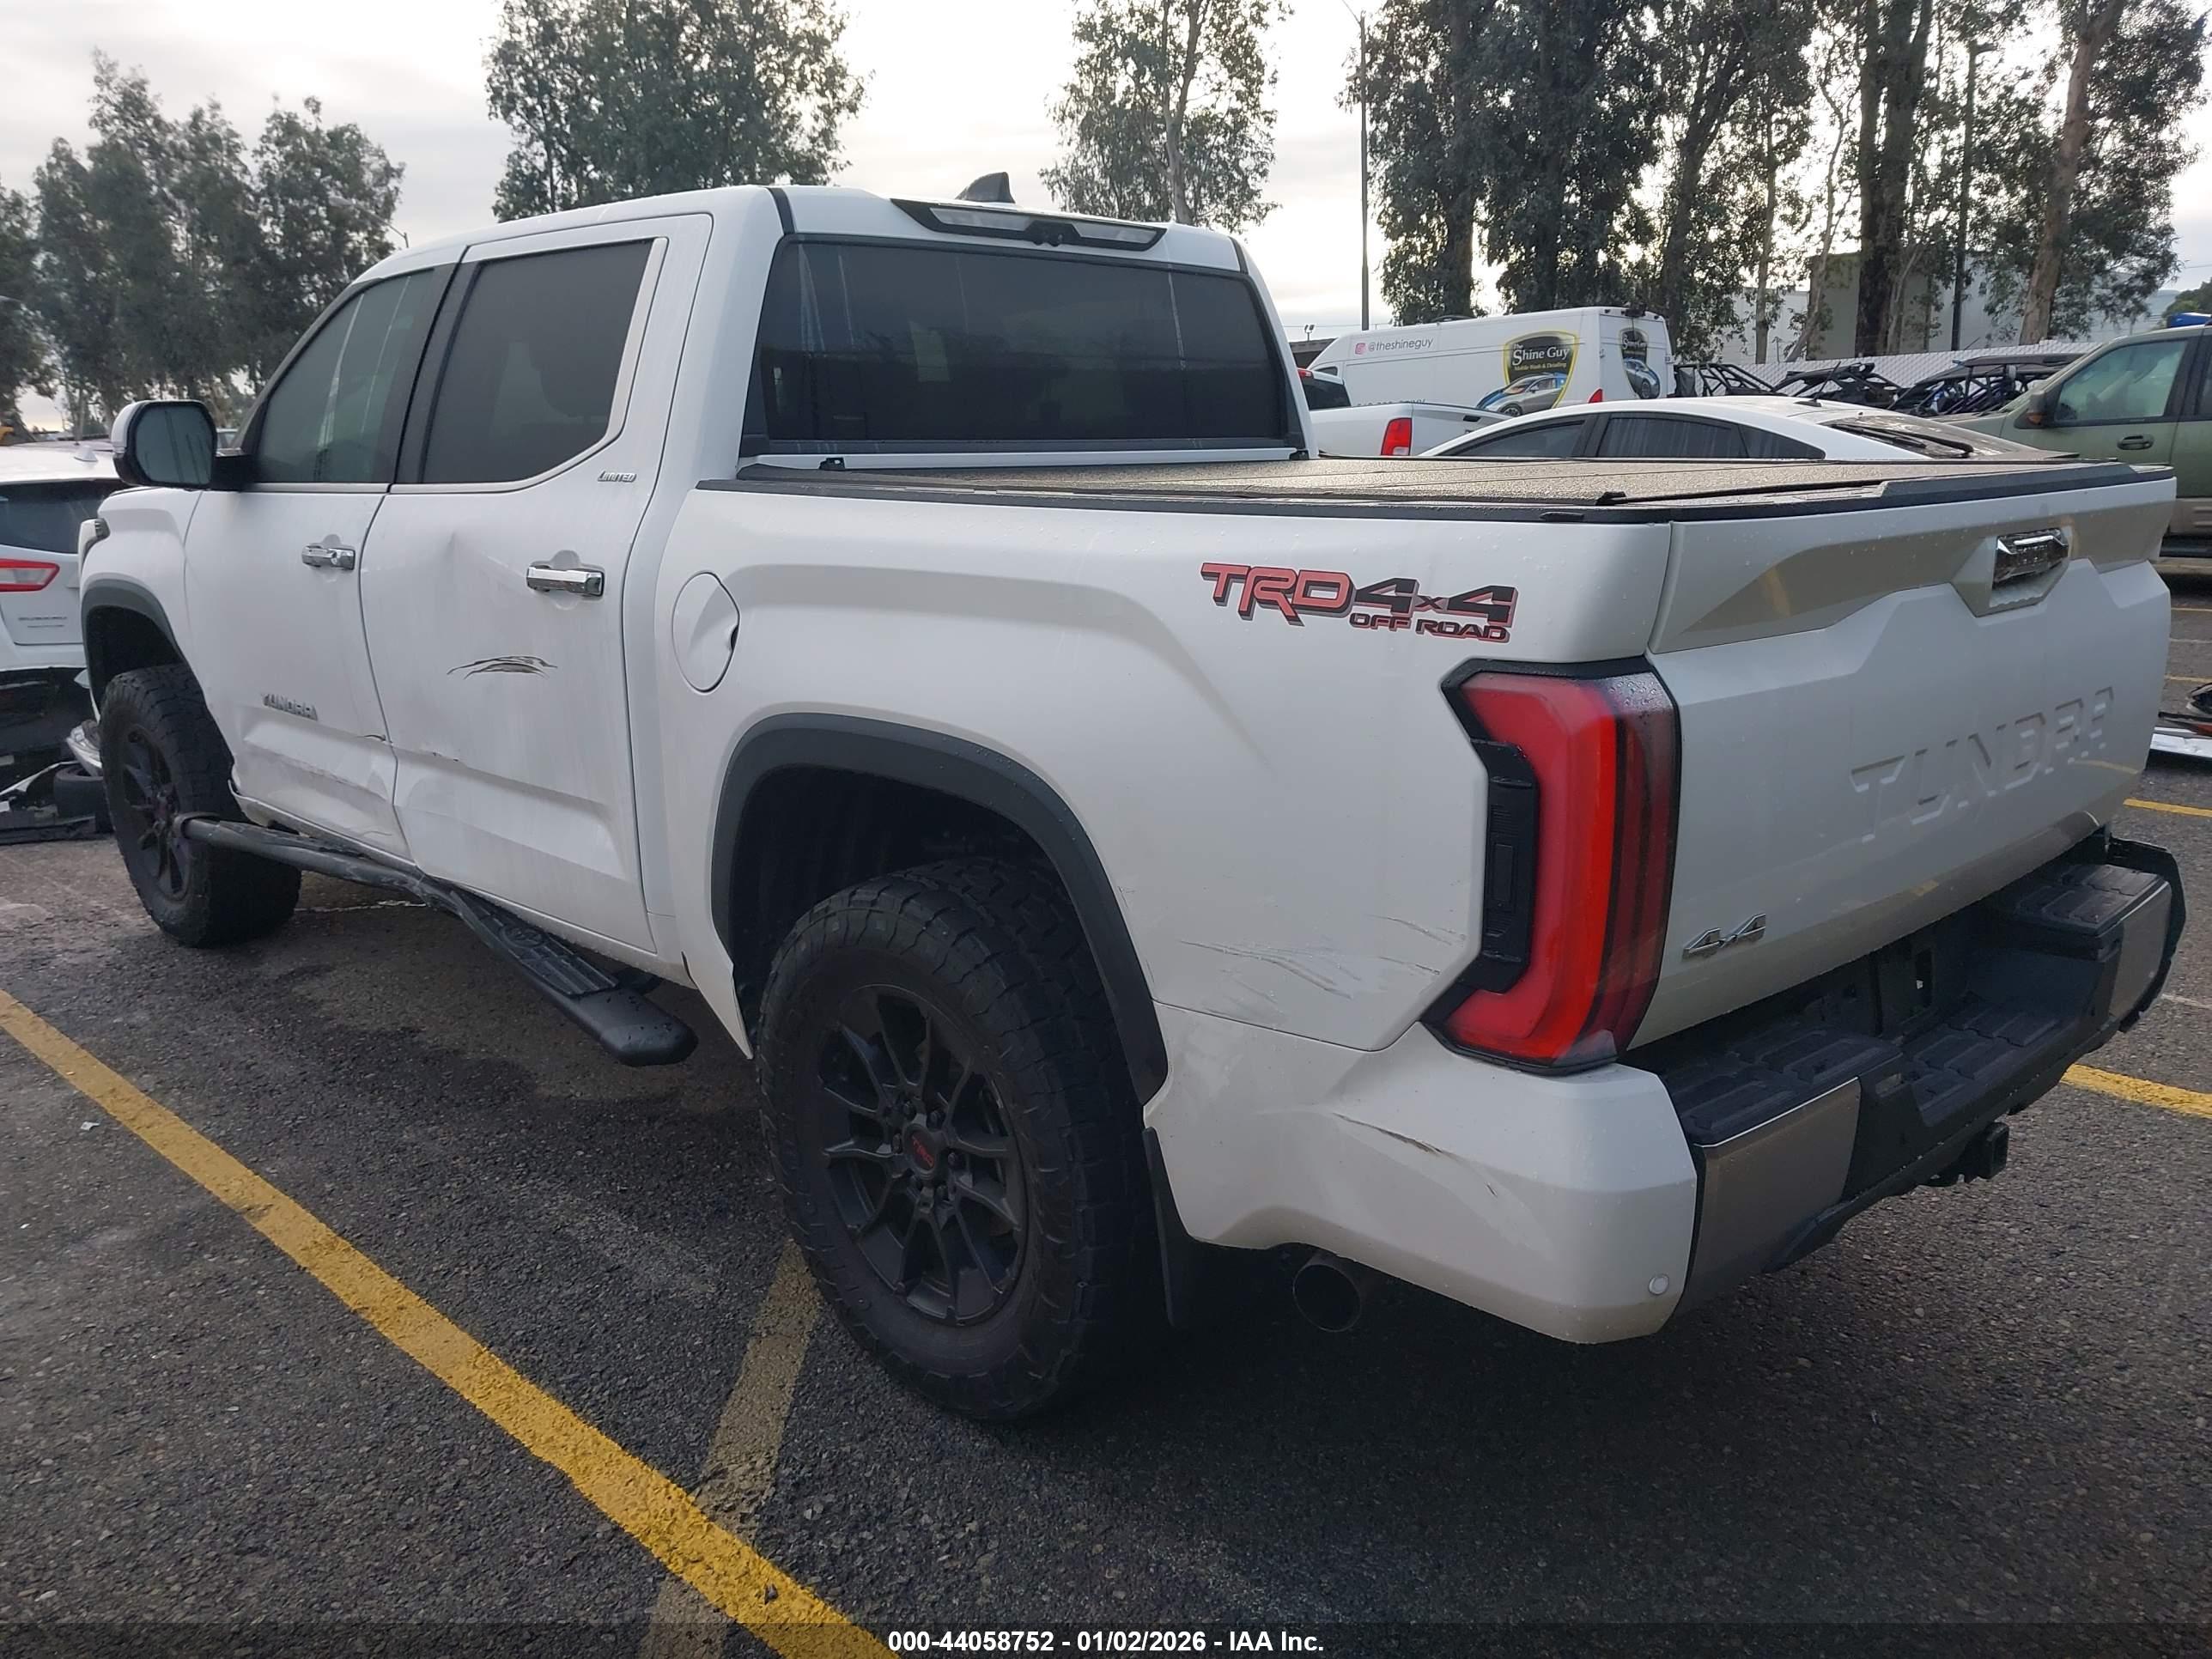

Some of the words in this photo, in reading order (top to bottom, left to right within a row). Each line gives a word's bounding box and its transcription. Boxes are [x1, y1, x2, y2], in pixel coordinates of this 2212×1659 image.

[1368, 338, 1433, 352] @theshineguy
[1512, 349, 1545, 366] Shine
[1547, 347, 1570, 361] Guy
[1200, 562, 1356, 627] TRD
[1349, 612, 1413, 633] OFF
[1415, 618, 1510, 644] ROAD
[261, 694, 318, 721] TUNDRA
[1849, 687, 2115, 843] TUNDRA
